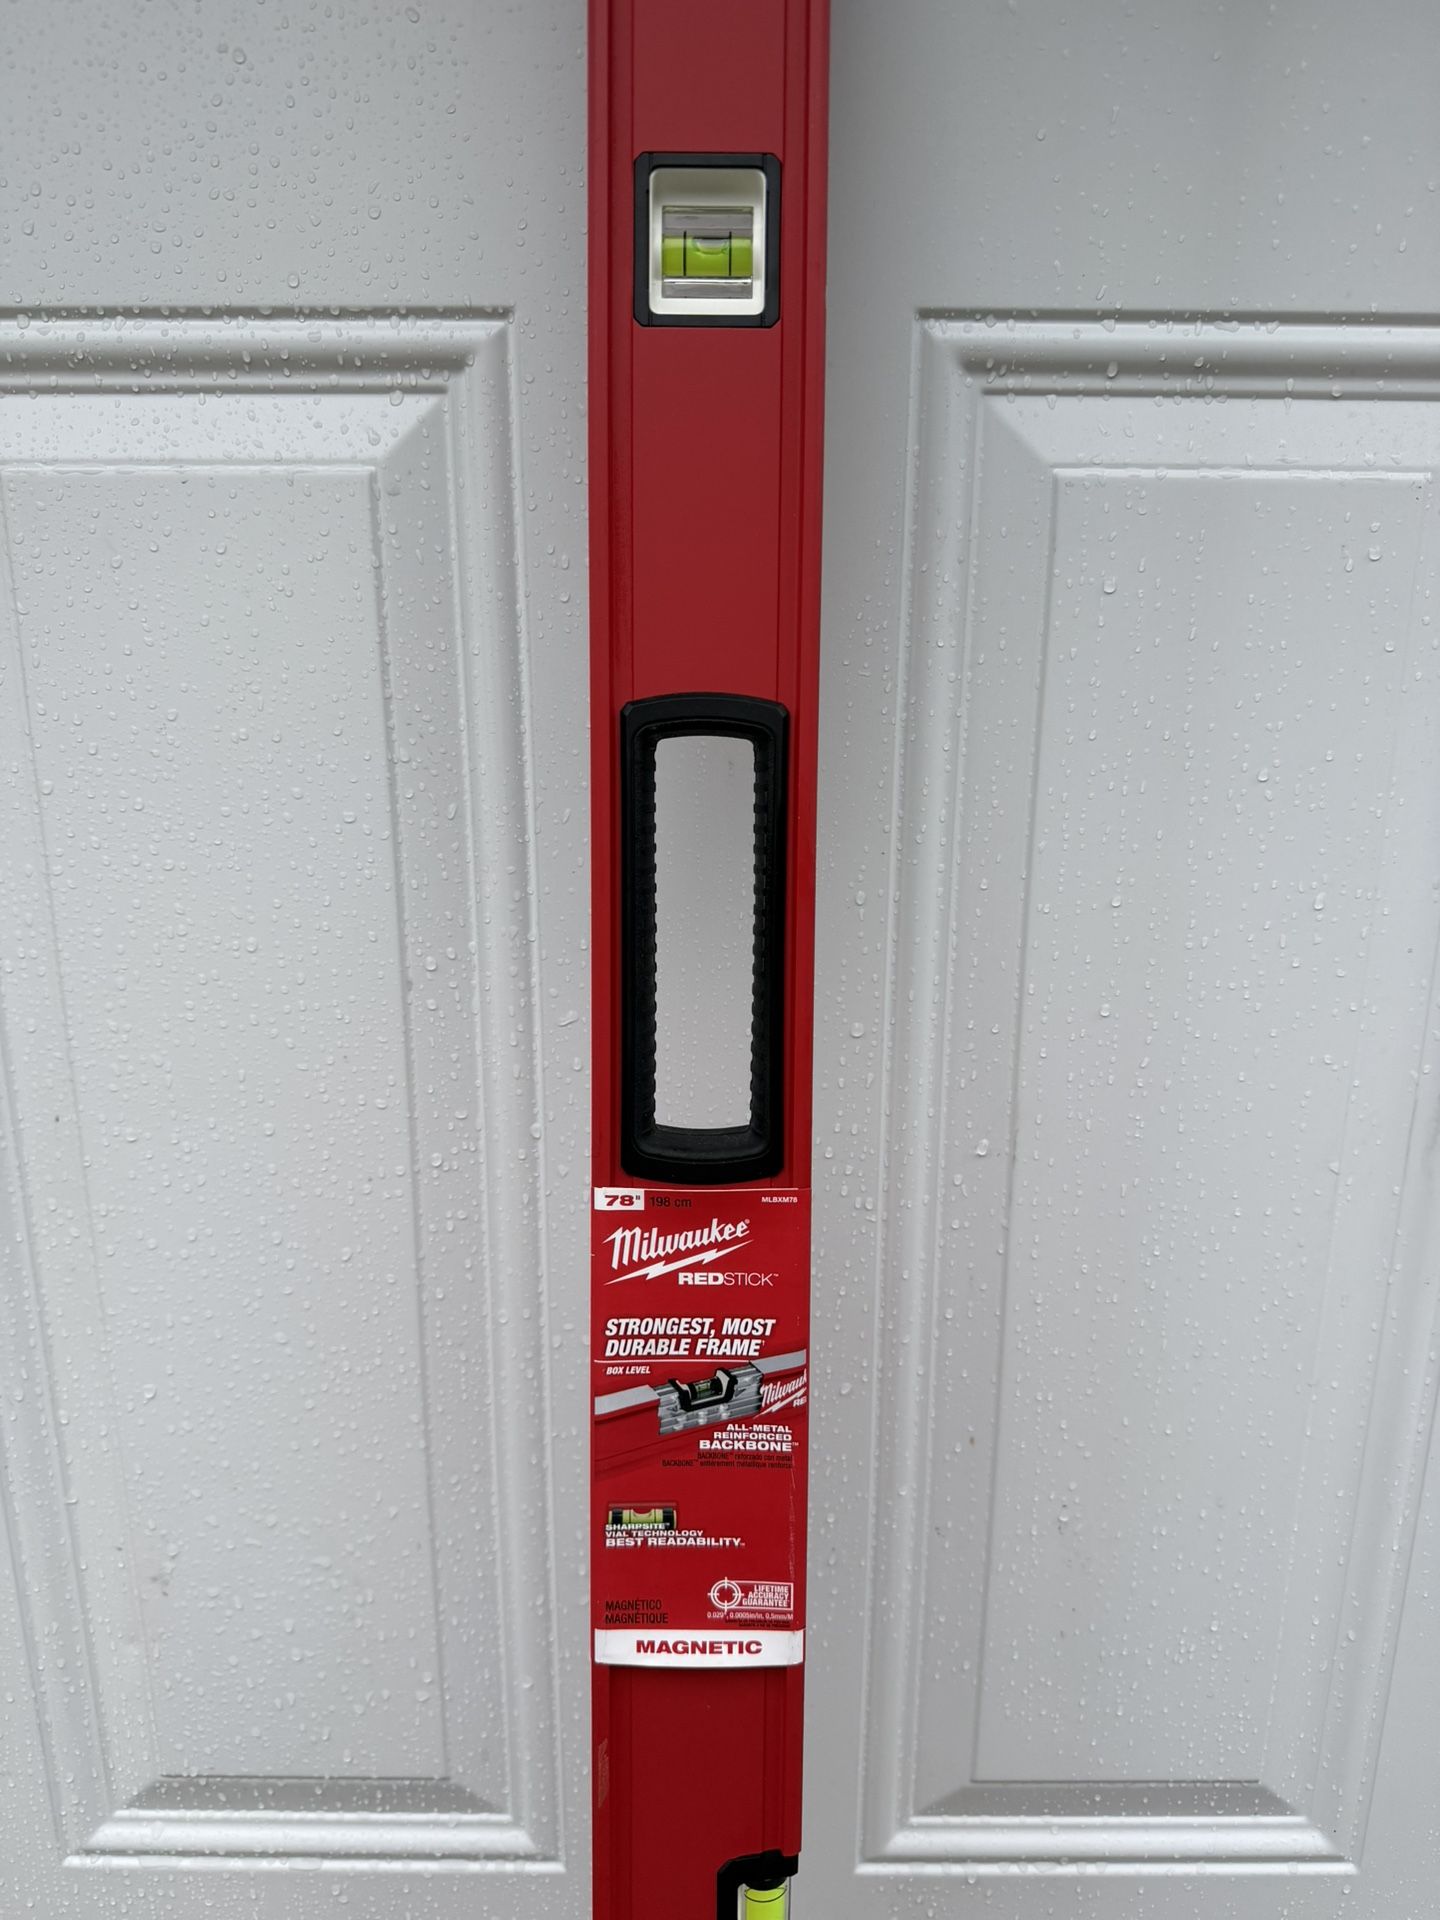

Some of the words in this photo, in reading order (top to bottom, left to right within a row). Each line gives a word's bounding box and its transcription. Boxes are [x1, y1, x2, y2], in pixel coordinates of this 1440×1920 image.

[651, 1197, 672, 1207] 198
[674, 1198, 692, 1208] cm
[605, 1318, 716, 1338] STRONGEST,
[721, 1318, 776, 1336] MOST
[605, 1339, 691, 1357] DURABLE
[606, 1366, 624, 1375] BOX
[625, 1365, 651, 1374] LEVEL
[726, 1423, 792, 1433] ALL-METAL
[713, 1432, 792, 1441] REINFORCED
[605, 1530, 629, 1538] VIAL
[606, 1537, 644, 1547] BEST
[754, 1584, 789, 1593] LIFETIME
[748, 1591, 789, 1600] ACCURACY
[636, 1640, 763, 1655] MAGNETIC
